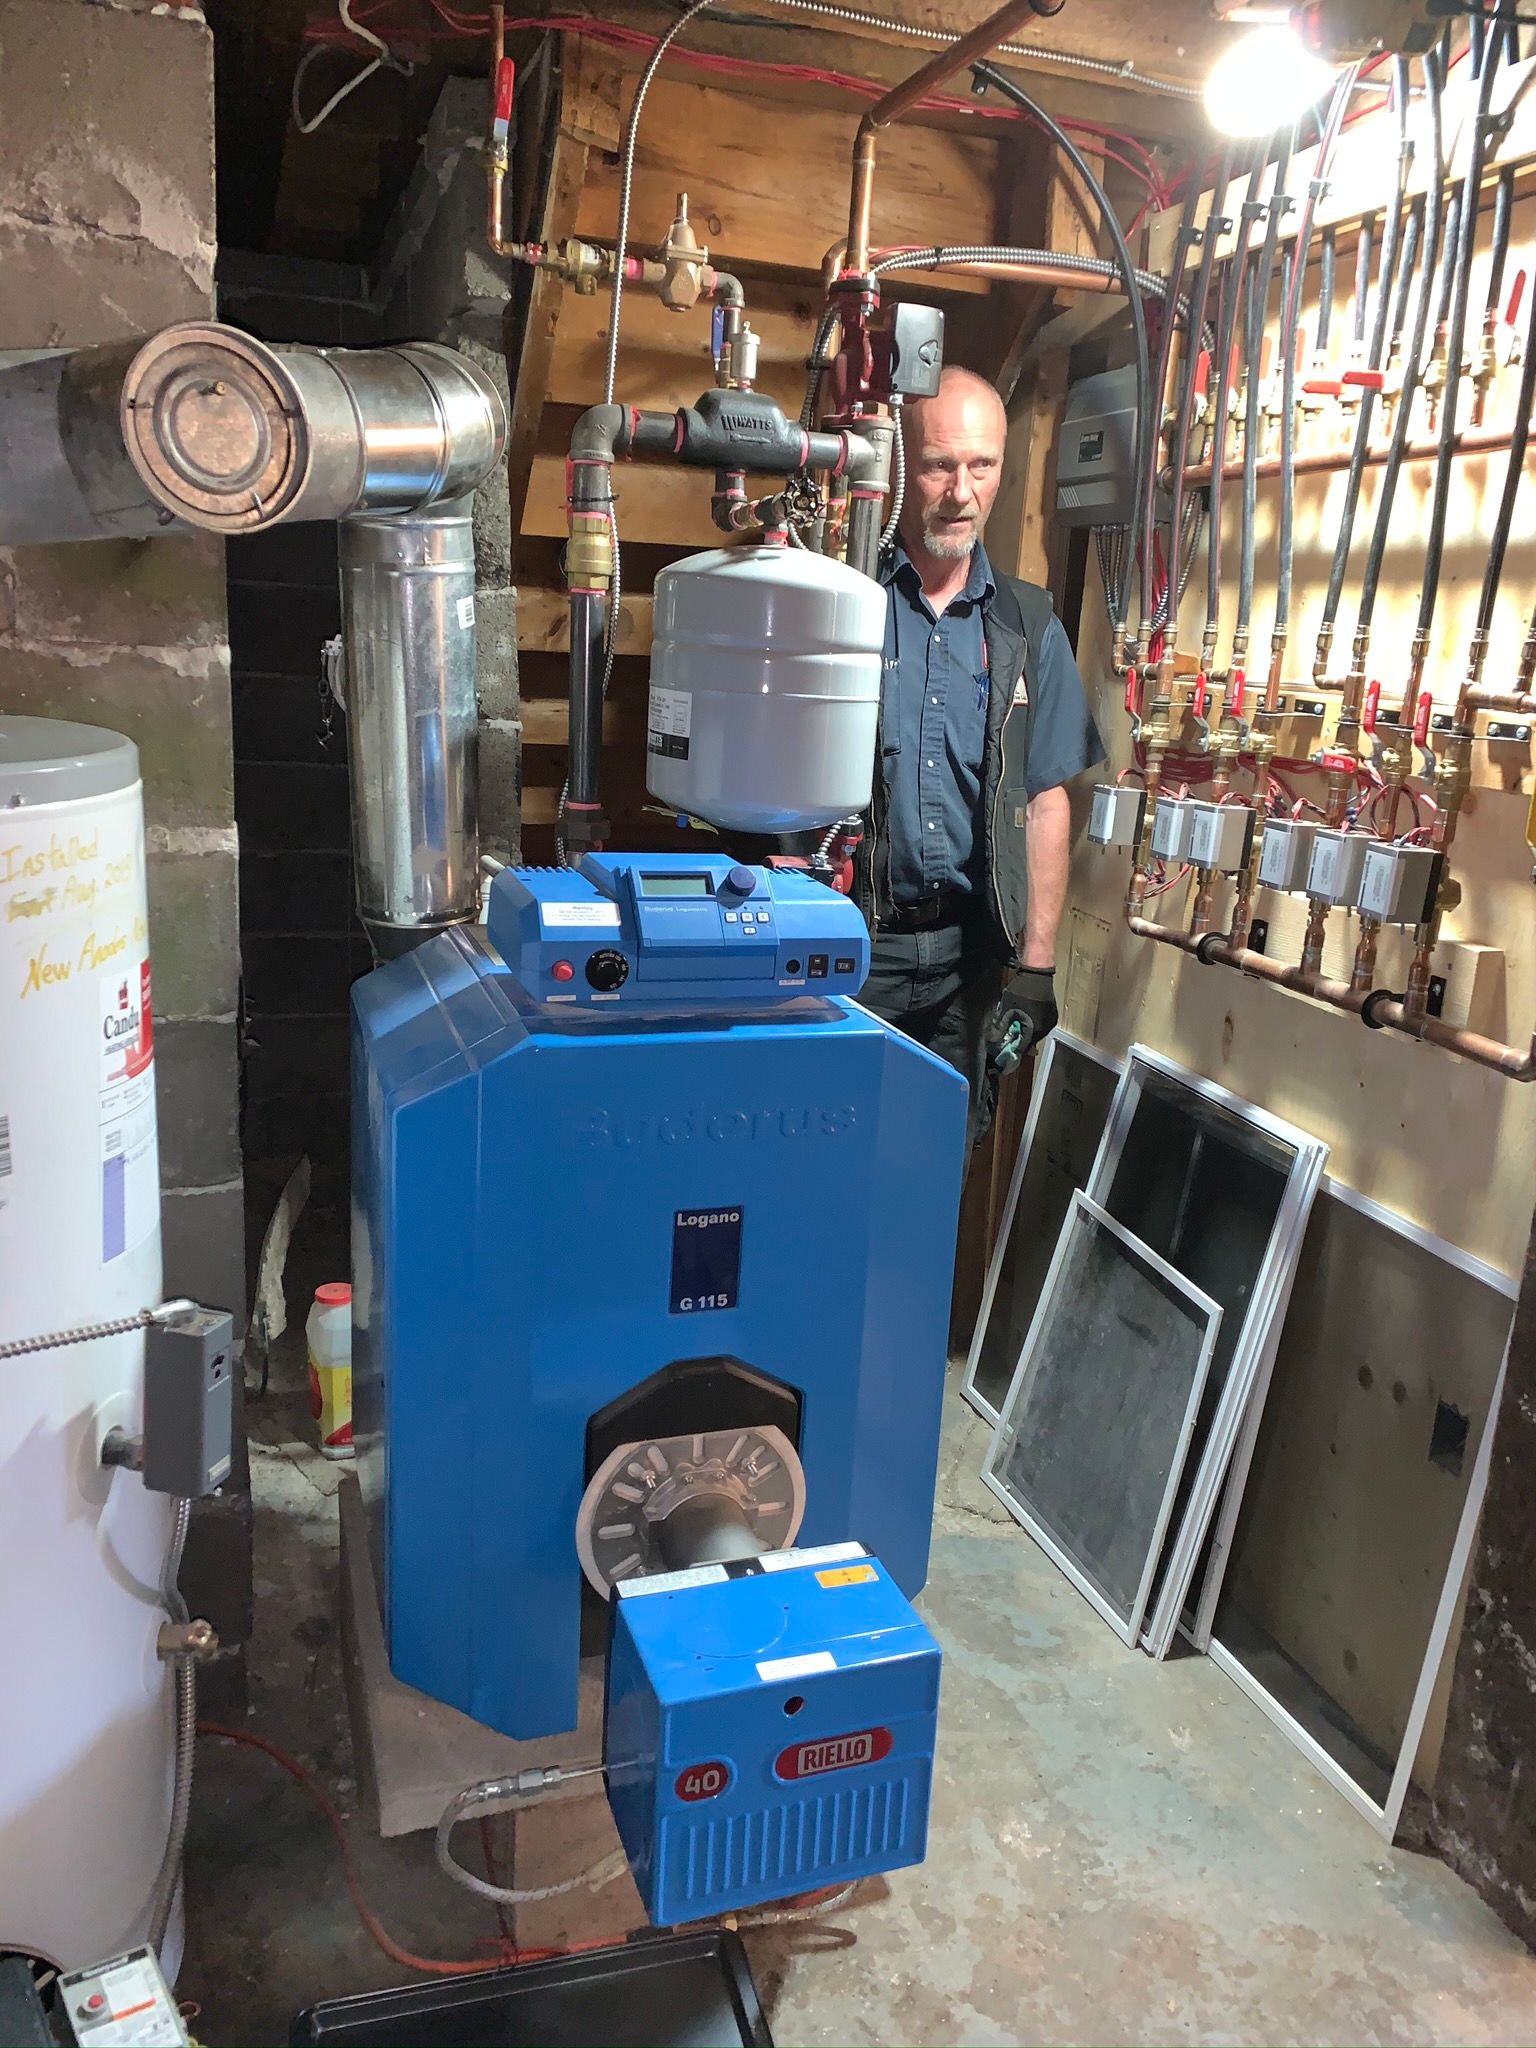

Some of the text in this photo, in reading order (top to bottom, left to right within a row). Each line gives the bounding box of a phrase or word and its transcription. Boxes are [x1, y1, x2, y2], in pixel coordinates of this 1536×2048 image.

[722, 414, 774, 431] WATTS
[0, 826, 98, 884] Installed
[20, 943, 71, 999] New
[677, 1212, 740, 1228] Logano
[679, 1293, 728, 1311] G 115
[803, 1738, 868, 1771] RIELLO
[684, 1769, 721, 1795] 40
